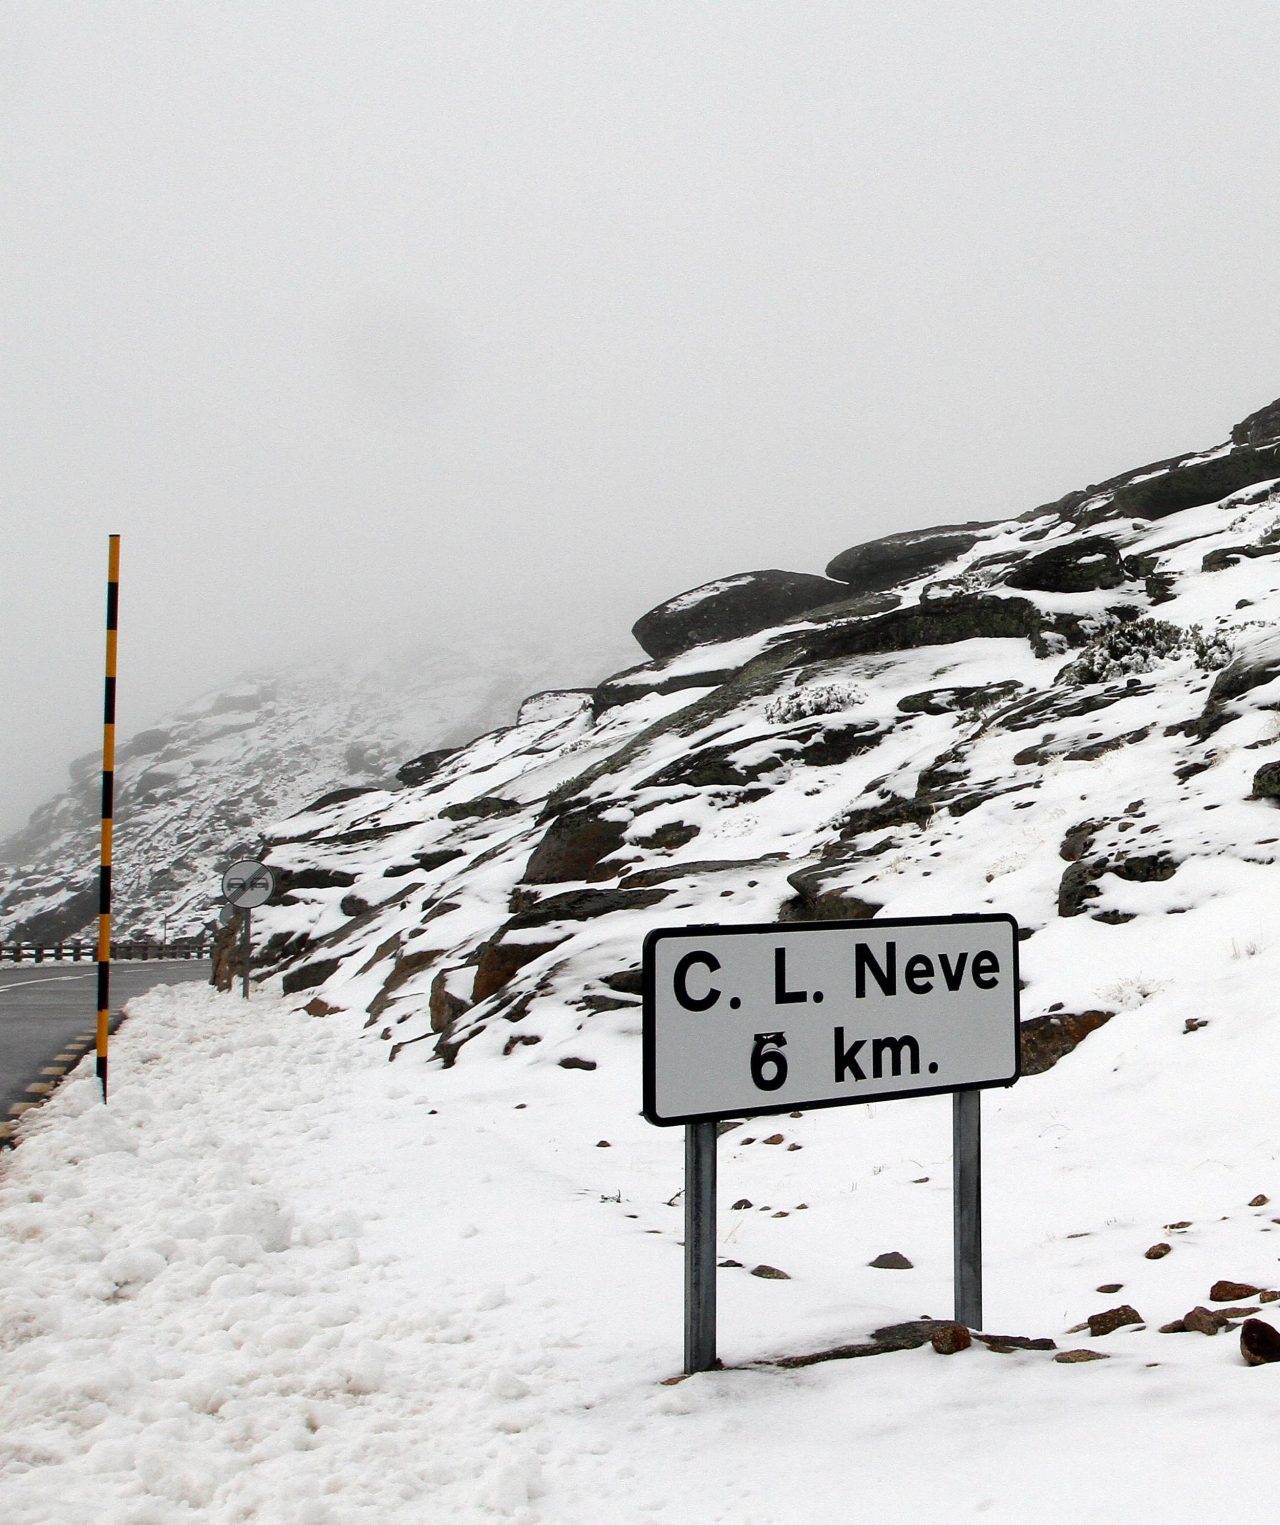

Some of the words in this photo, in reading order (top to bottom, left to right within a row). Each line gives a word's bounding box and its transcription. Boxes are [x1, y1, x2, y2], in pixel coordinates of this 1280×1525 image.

[673, 950, 742, 1013] C.
[774, 946, 825, 1005] L.
[854, 940, 1001, 999] Neve
[750, 1031, 789, 1092] 6
[833, 1026, 940, 1083] km.
